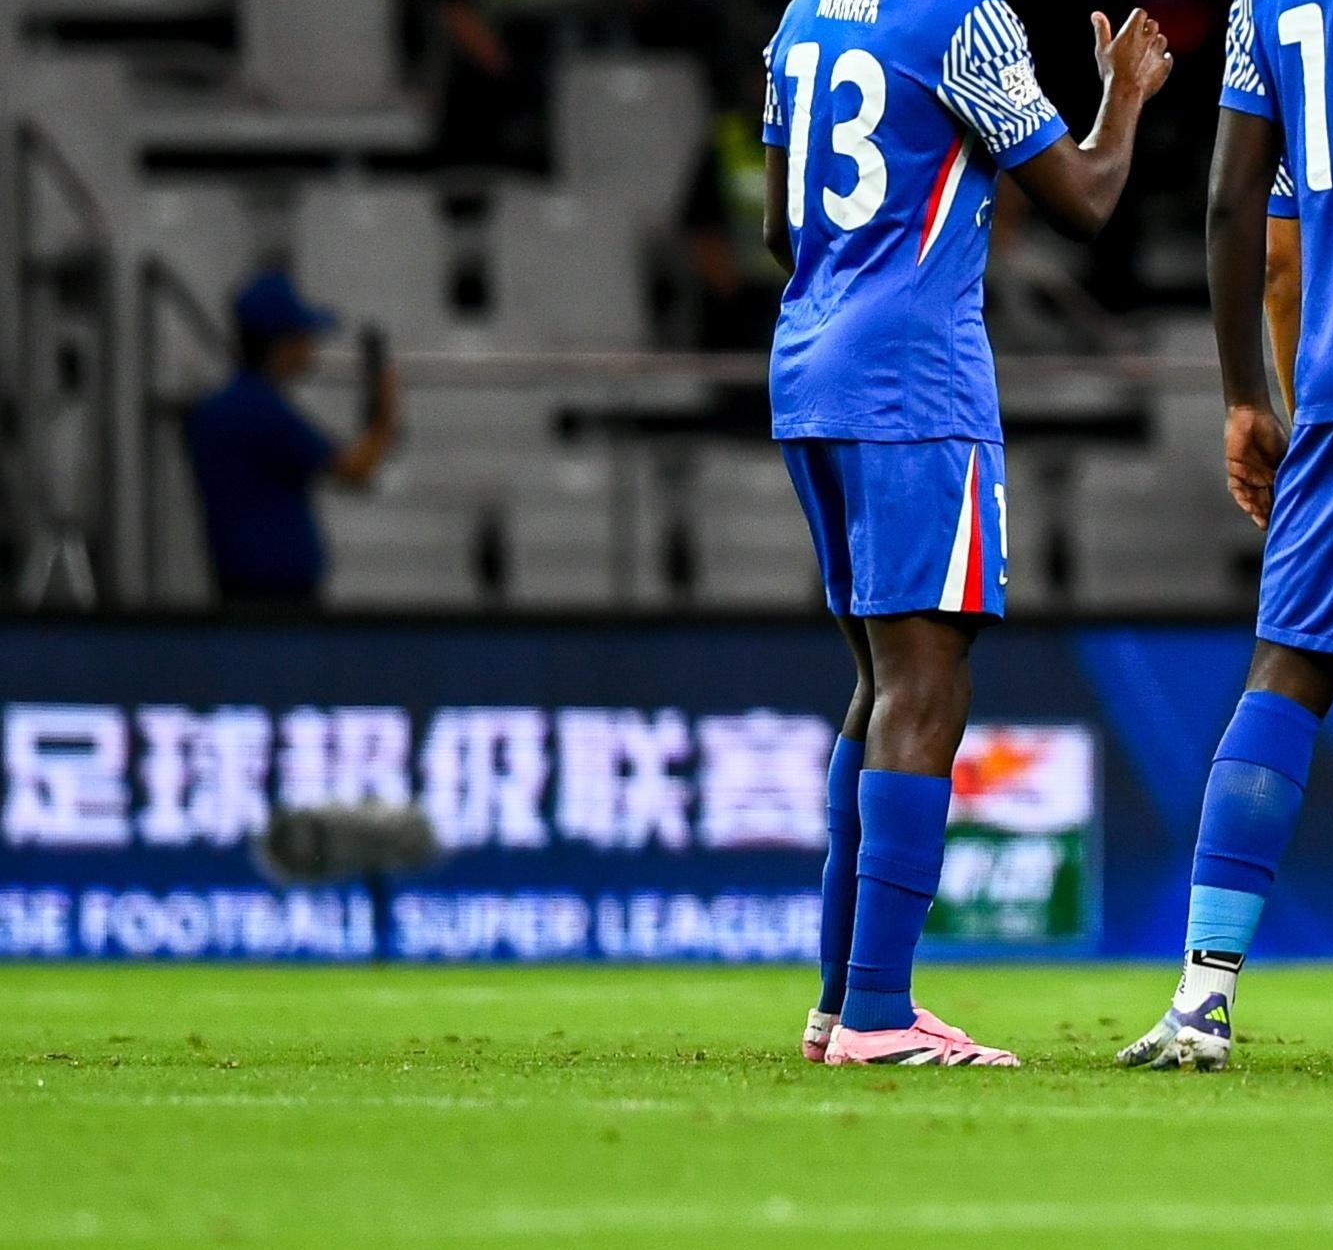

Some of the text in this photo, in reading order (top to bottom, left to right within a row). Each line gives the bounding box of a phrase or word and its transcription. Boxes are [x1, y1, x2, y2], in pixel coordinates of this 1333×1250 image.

[784, 41, 888, 231] 13
[3, 703, 832, 848] 足球超级联赛
[394, 893, 588, 957] SUPER
